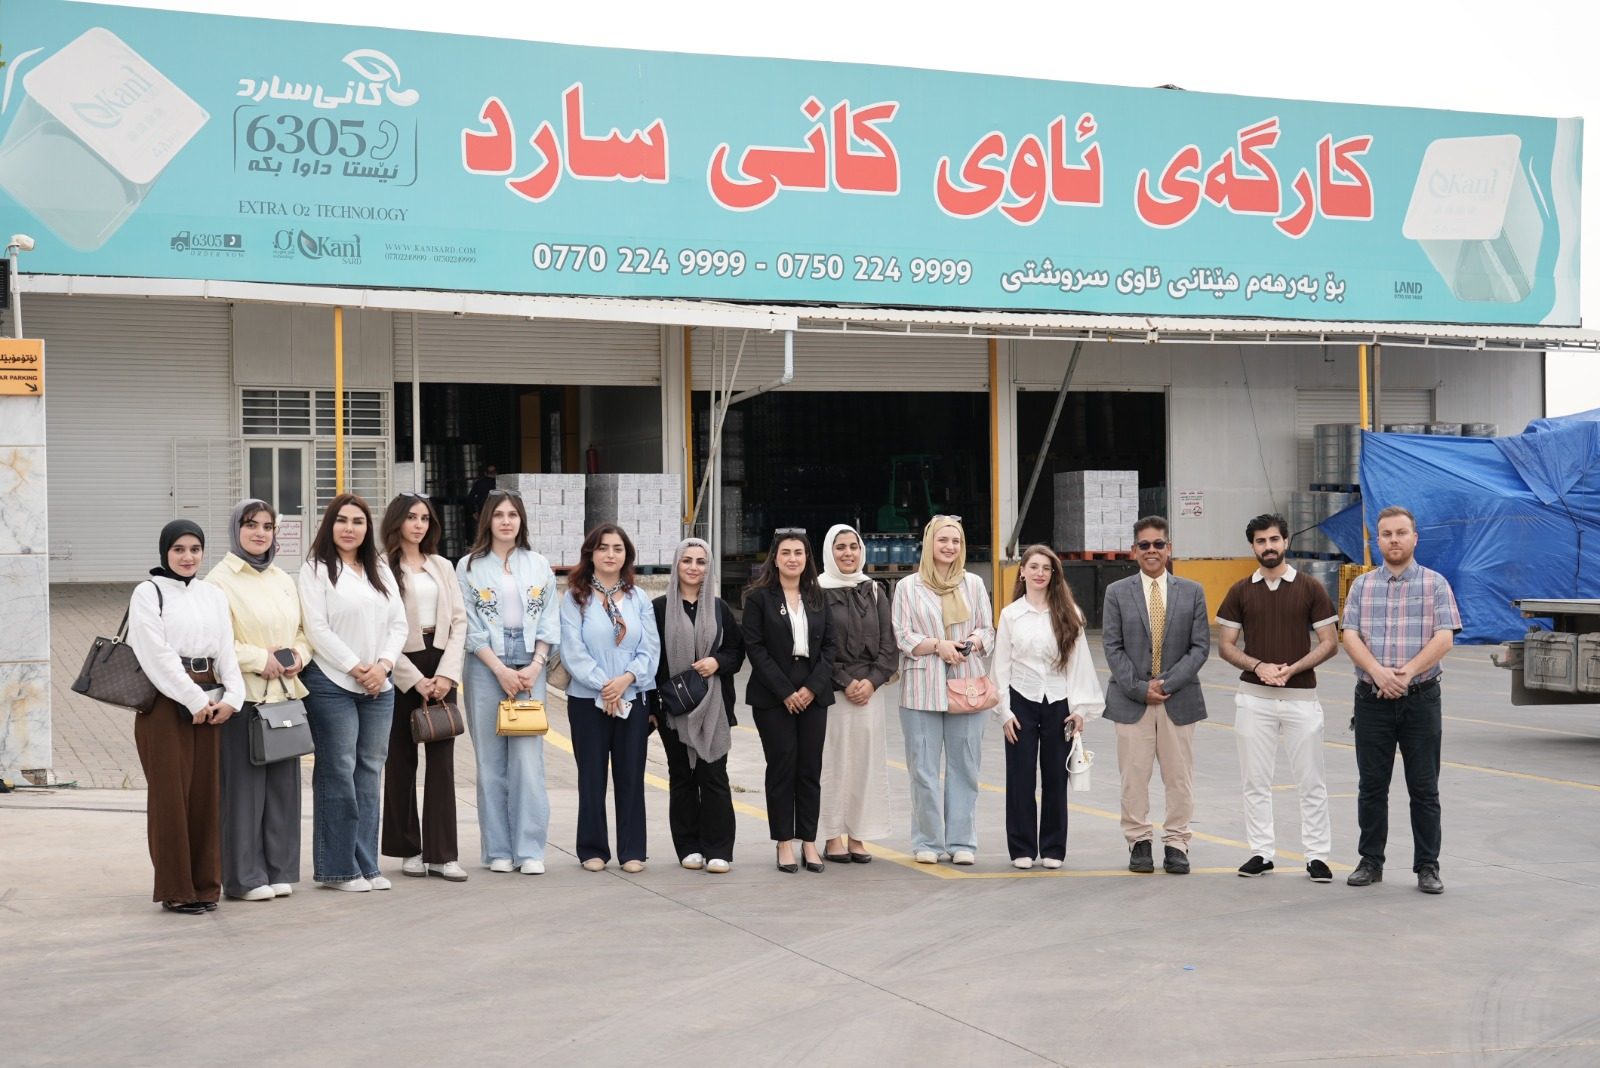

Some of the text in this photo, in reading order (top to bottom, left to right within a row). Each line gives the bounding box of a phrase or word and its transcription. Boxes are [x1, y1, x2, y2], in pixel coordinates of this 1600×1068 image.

[236, 75, 312, 102] سارد
[246, 114, 367, 158] 6305
[292, 158, 333, 178] داوا
[461, 81, 1375, 239] کارگەی ئاوی کانی سارد
[239, 200, 409, 222] EXTRA O2 TECHNOLOGY
[192, 233, 223, 248] 6305
[317, 233, 362, 258] Kani
[532, 243, 608, 272] 0770
[617, 247, 670, 275] 224
[678, 248, 746, 277] 9999
[776, 252, 844, 280] 0750
[853, 255, 902, 282] 224
[909, 257, 973, 286] 9999
[1001, 256, 1346, 303] بۆ بەرهەم هێنانی ئاوی سروشتی
[1394, 281, 1423, 294] LAND
